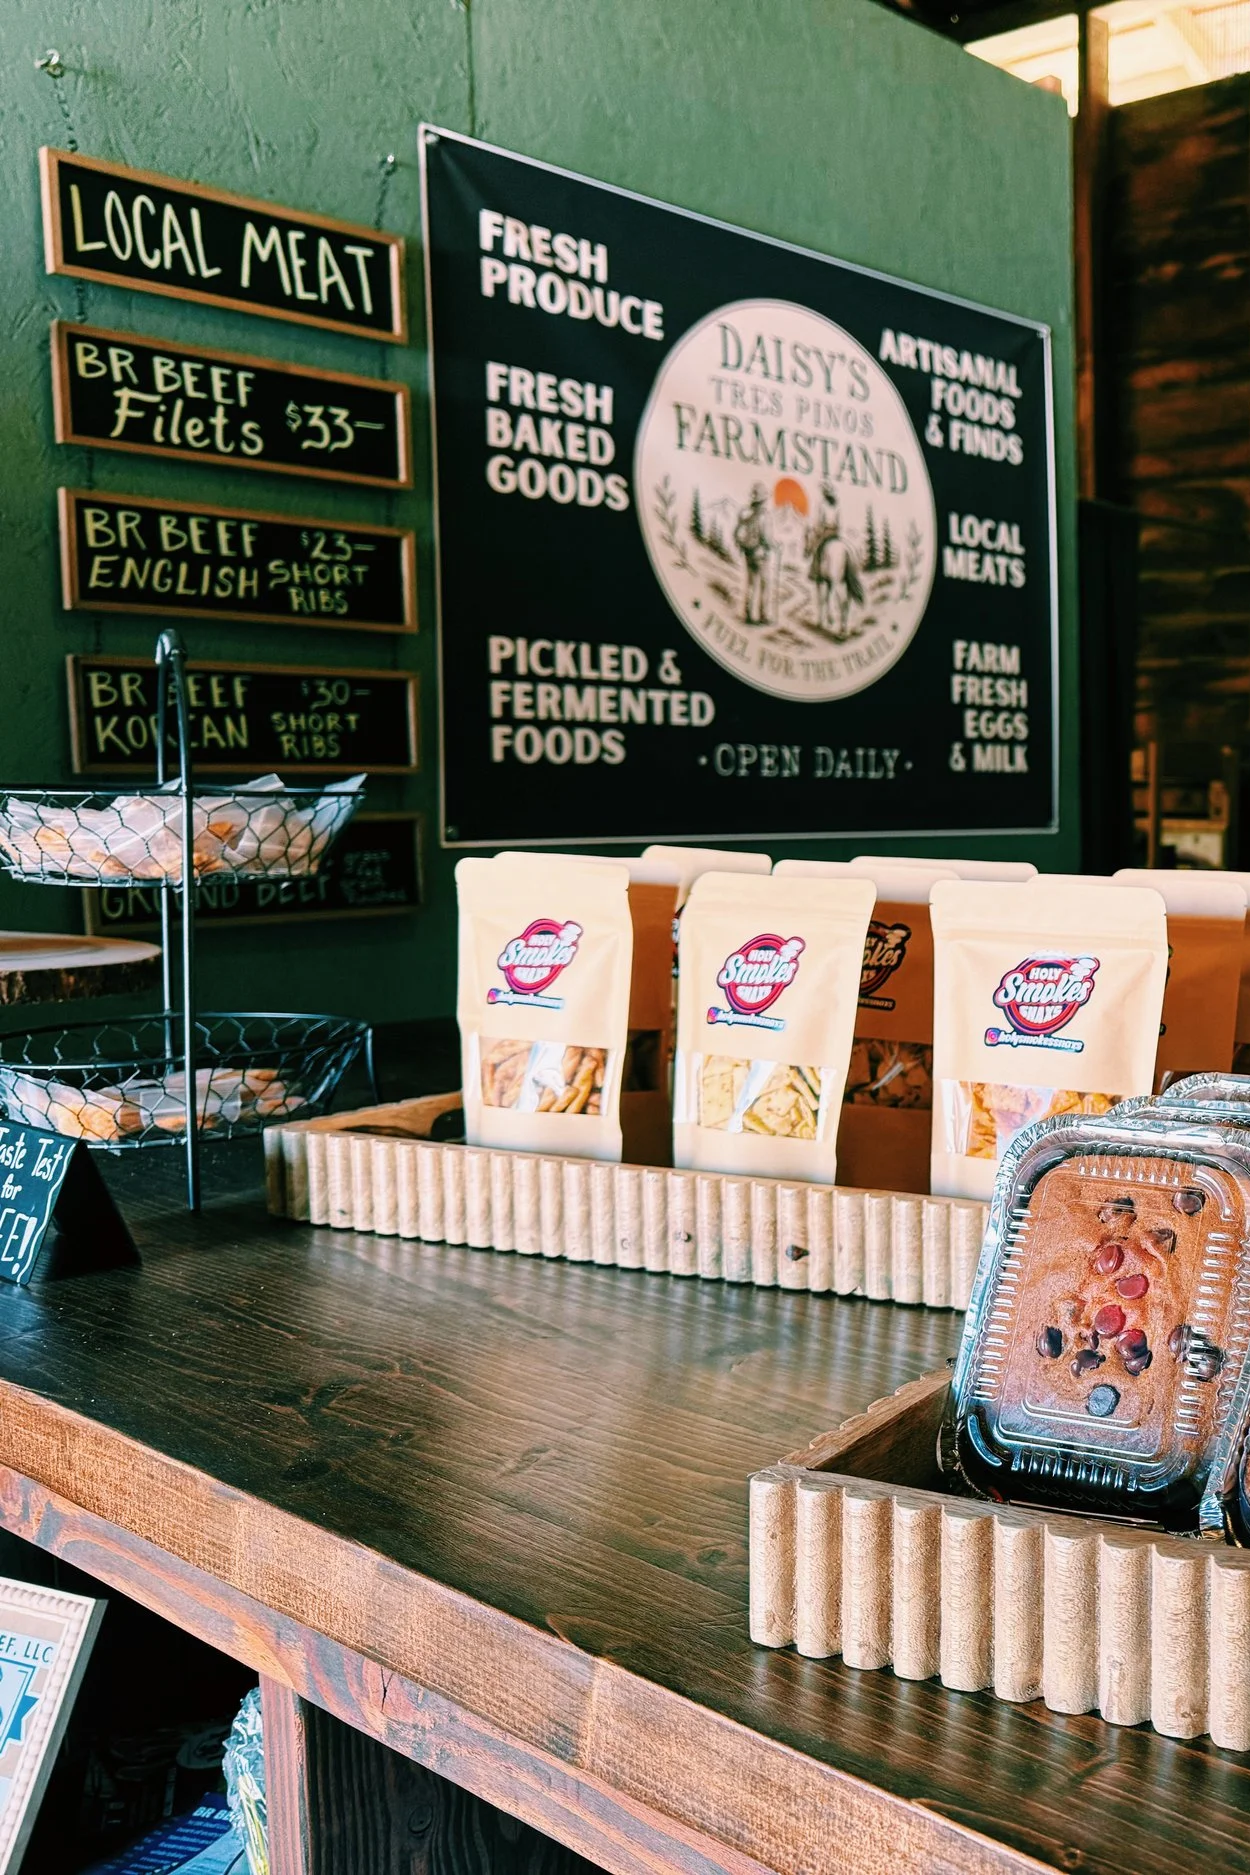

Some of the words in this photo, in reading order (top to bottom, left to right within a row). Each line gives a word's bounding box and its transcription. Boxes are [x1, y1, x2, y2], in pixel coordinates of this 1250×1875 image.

[70, 184, 222, 279] LOCAL
[241, 220, 375, 315] MEAT
[479, 208, 608, 284] FRESH
[480, 256, 665, 341] PRODUCE
[75, 342, 140, 385] BR
[153, 356, 255, 408] BEEF
[717, 321, 871, 402] DAISY'S
[879, 327, 1023, 399] ARTISANAL
[485, 360, 613, 425] FRESH
[710, 375, 783, 408] TRES
[796, 396, 874, 438] PINOS
[931, 377, 1016, 430] FOODS
[110, 386, 265, 456] Filets
[485, 407, 615, 467] BAKED
[924, 413, 944, 448] &
[949, 419, 1023, 466] FINDS
[672, 402, 908, 495] FARMSTAND
[486, 454, 630, 511] GOODS
[83, 507, 147, 550] BR
[158, 515, 259, 558] BEEF
[949, 511, 1026, 556] LOCAL
[88, 555, 259, 599] ENGLISH
[268, 559, 370, 590] SHORT
[943, 546, 1026, 589] MEATS
[288, 586, 350, 615] RIBS
[488, 635, 648, 683] PICKLED
[658, 649, 682, 685] &
[953, 639, 1021, 675] FARM
[86, 672, 147, 708] BR
[489, 680, 715, 727] FERMENTED
[952, 674, 1028, 709] FRESH
[270, 711, 361, 733] SHORT
[964, 709, 1029, 741] EGGS
[282, 732, 340, 759] RIBS
[490, 725, 626, 765] FOODS
[714, 743, 801, 777] OPEN
[814, 746, 900, 779] DAILY
[950, 742, 966, 772] &
[973, 743, 1029, 773] MILK
[719, 953, 797, 984] Smokes
[998, 972, 1091, 1003] Smokes
[1028, 967, 1063, 980] HOLY
[31, 1138, 63, 1181] Test
[1, 1173, 22, 1200] for
